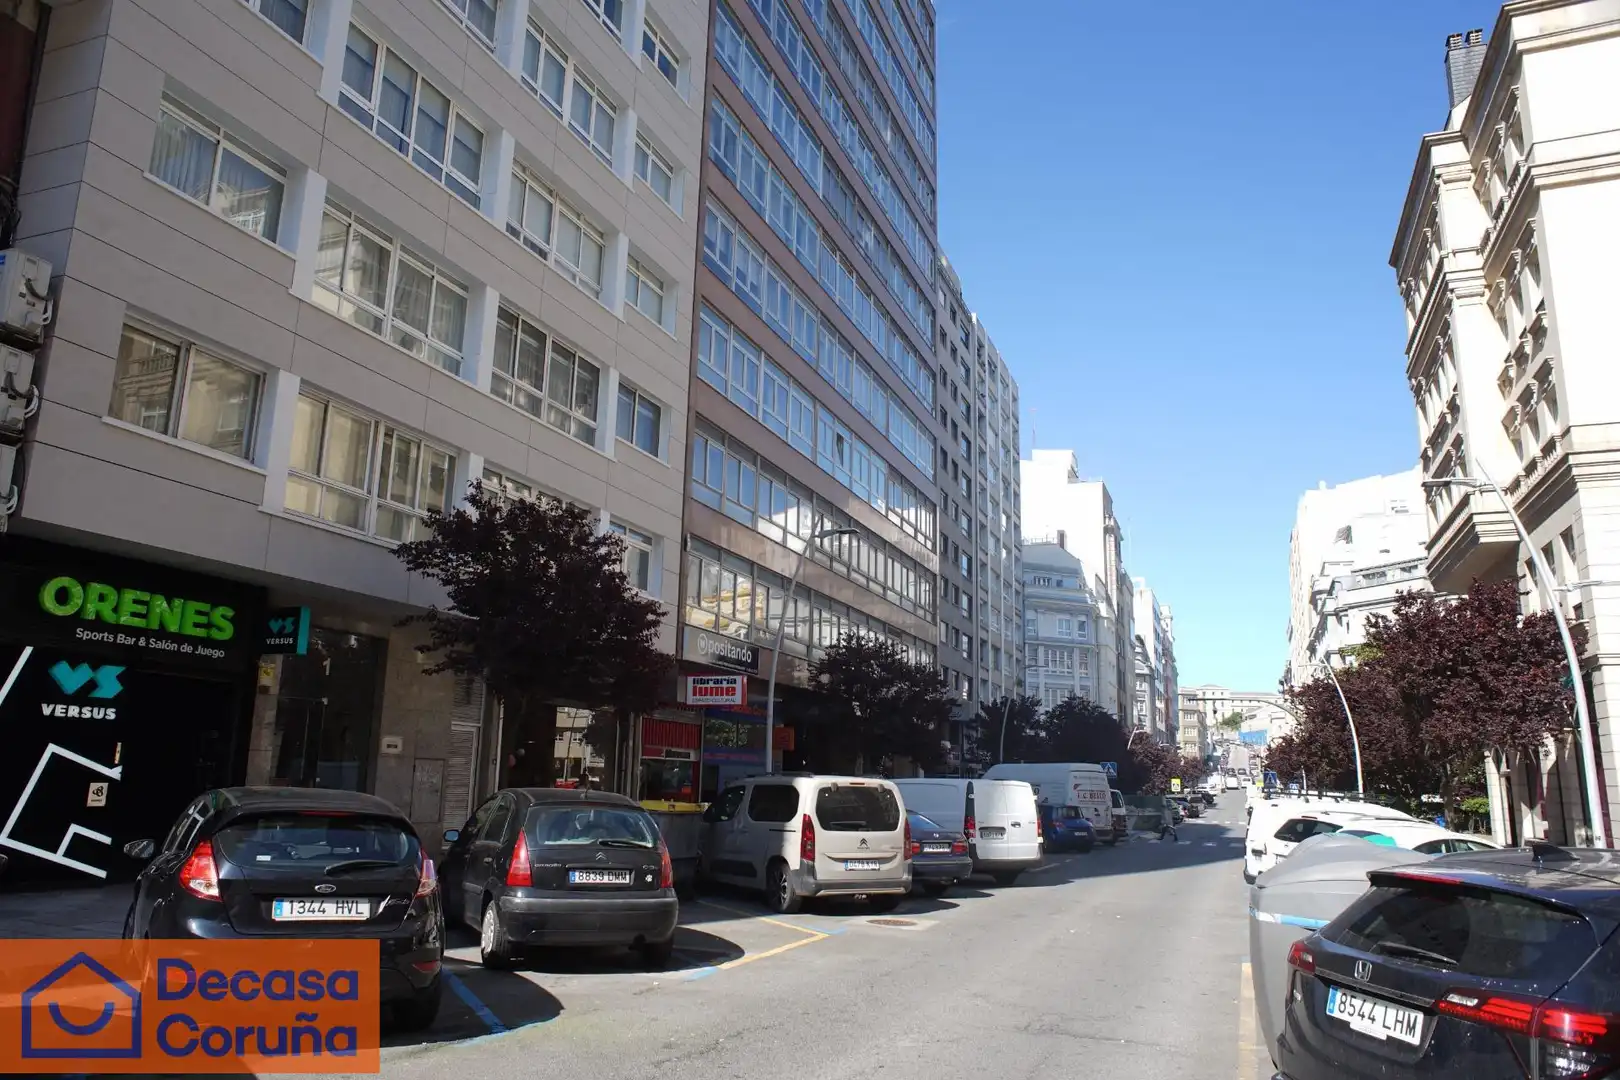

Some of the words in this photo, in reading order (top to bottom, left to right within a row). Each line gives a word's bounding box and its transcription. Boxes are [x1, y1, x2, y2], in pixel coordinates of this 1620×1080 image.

[39, 576, 235, 640] ORENES
[76, 628, 114, 642] Sports
[117, 634, 135, 645] Bar
[138, 637, 146, 647] &
[149, 638, 178, 651] Salón
[180, 643, 193, 653] de
[195, 645, 225, 658] Juego
[267, 637, 294, 645] VERSUS
[692, 686, 736, 696] lume
[41, 703, 117, 720] VERSUS
[578, 871, 604, 881] 8839
[607, 871, 627, 882] DMM
[289, 900, 326, 914] 1344
[335, 900, 365, 915] HVL
[1338, 993, 1377, 1025] 8544
[1382, 1005, 1418, 1038] LHM
